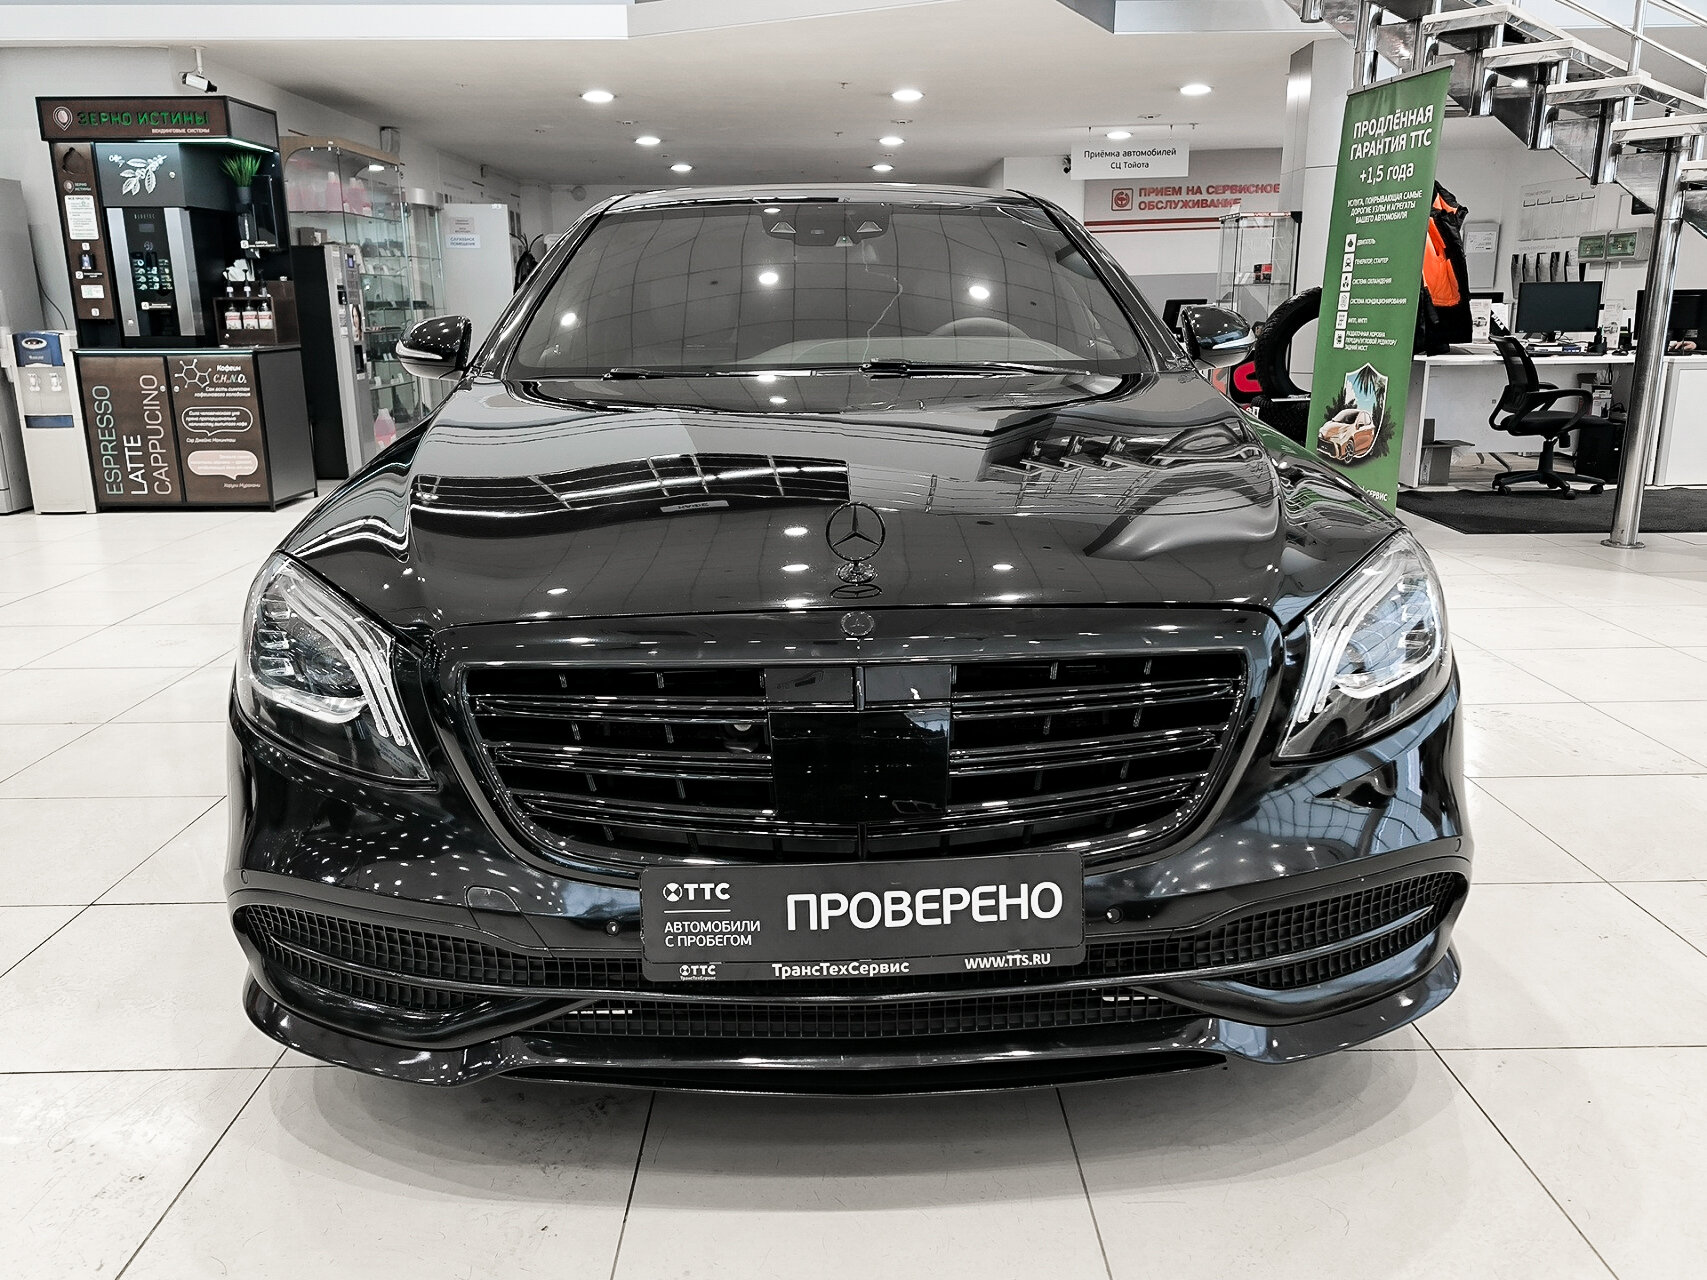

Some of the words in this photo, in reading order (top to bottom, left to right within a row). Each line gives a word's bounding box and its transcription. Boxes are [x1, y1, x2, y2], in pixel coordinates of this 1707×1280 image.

[77, 111, 132, 126] ЗЕРНО
[137, 111, 210, 126] ИСТИНЫ
[1353, 104, 1434, 139] ПРОДЛЁННАЯ
[1084, 150, 1120, 159] Приёмка
[1122, 148, 1177, 157] автомобилей
[1350, 133, 1407, 161] ГАРАНТИЯ
[1410, 128, 1432, 149] ТТС
[1110, 161, 1122, 169] СЦ
[1123, 161, 1149, 169] Тойота
[1360, 164, 1384, 186] +1,5
[1387, 162, 1414, 182] года
[1138, 187, 1182, 198] ПРИЕМ
[1186, 185, 1203, 196] НА
[1206, 183, 1281, 195] СЕРВИСНОЕ
[1138, 197, 1242, 211] ОБСЛУЖИВАНИЕ
[92, 385, 124, 495] ESPRESSO
[139, 374, 172, 495] CAPPUCINO
[122, 434, 148, 495] LATTE
[683, 882, 731, 901] ТТС
[786, 881, 1064, 931] ПРОВЕРЕНО
[664, 920, 761, 933] АВТОМОБИЛИ
[665, 935, 675, 947] С
[677, 934, 752, 947] ПРОБЕГОМ
[691, 964, 716, 975] ТТС
[771, 961, 910, 979] ТрансТехСервис
